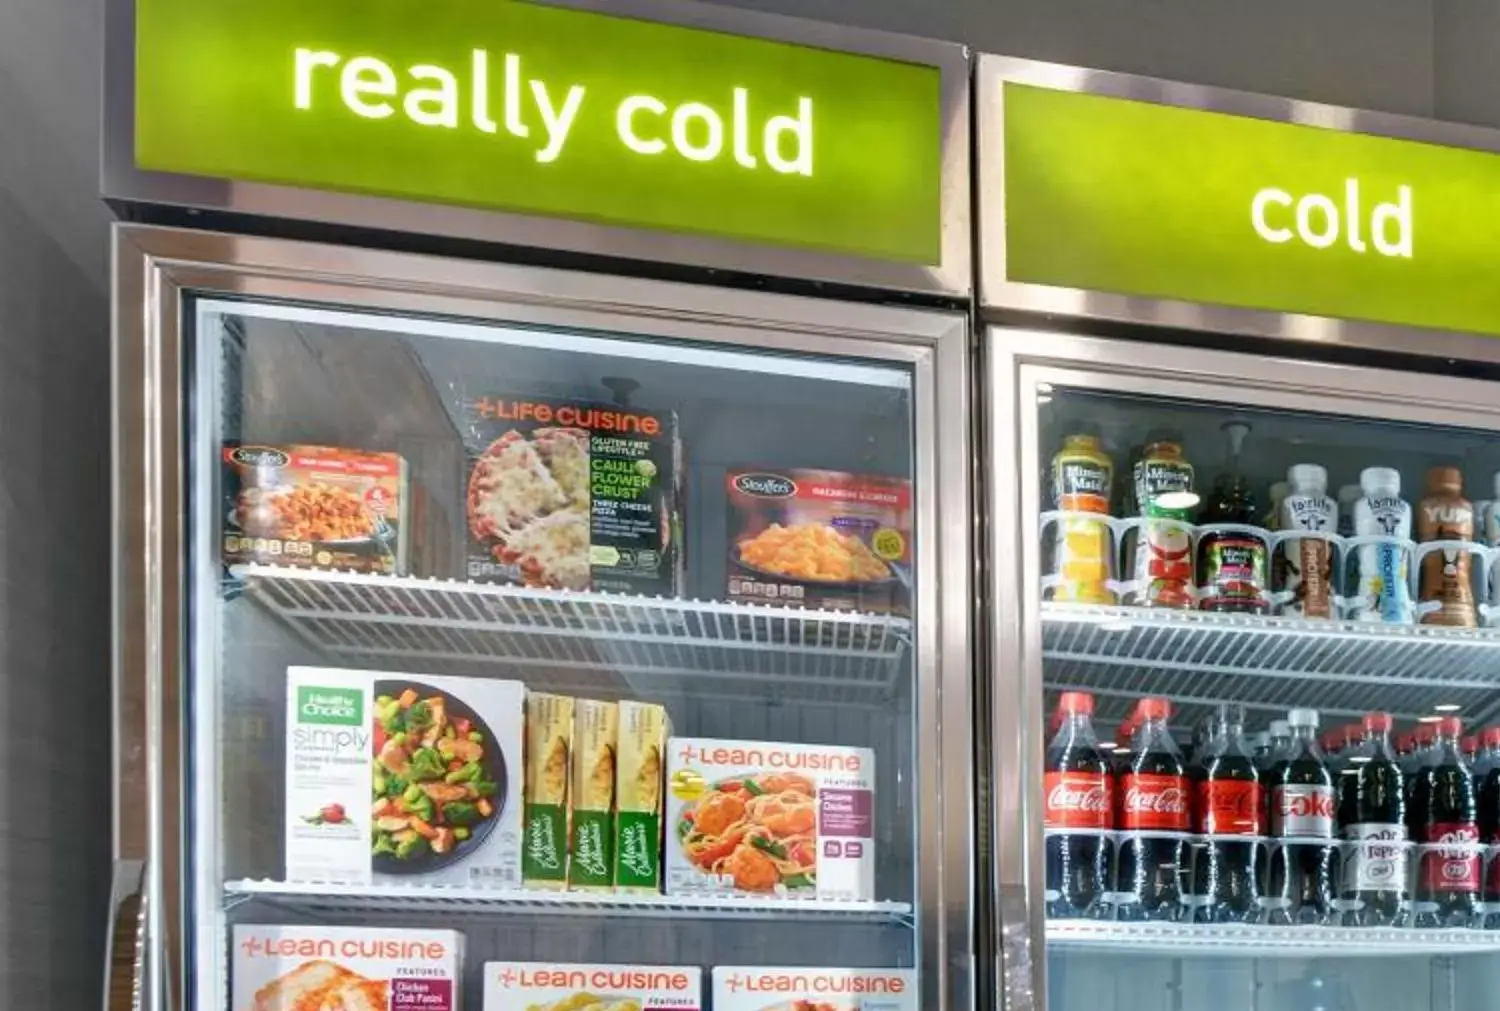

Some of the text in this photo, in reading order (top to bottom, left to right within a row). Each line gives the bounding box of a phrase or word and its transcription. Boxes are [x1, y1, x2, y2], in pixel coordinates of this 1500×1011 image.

[292, 47, 815, 177] really cold
[1251, 176, 1414, 258] cold
[592, 471, 651, 489] FLOWER
[592, 485, 637, 499] CRUST
[293, 727, 369, 754] simply
[700, 747, 762, 767] Lean
[266, 938, 334, 958] Lean
[520, 970, 585, 988] Lean
[746, 976, 809, 992] Lean
